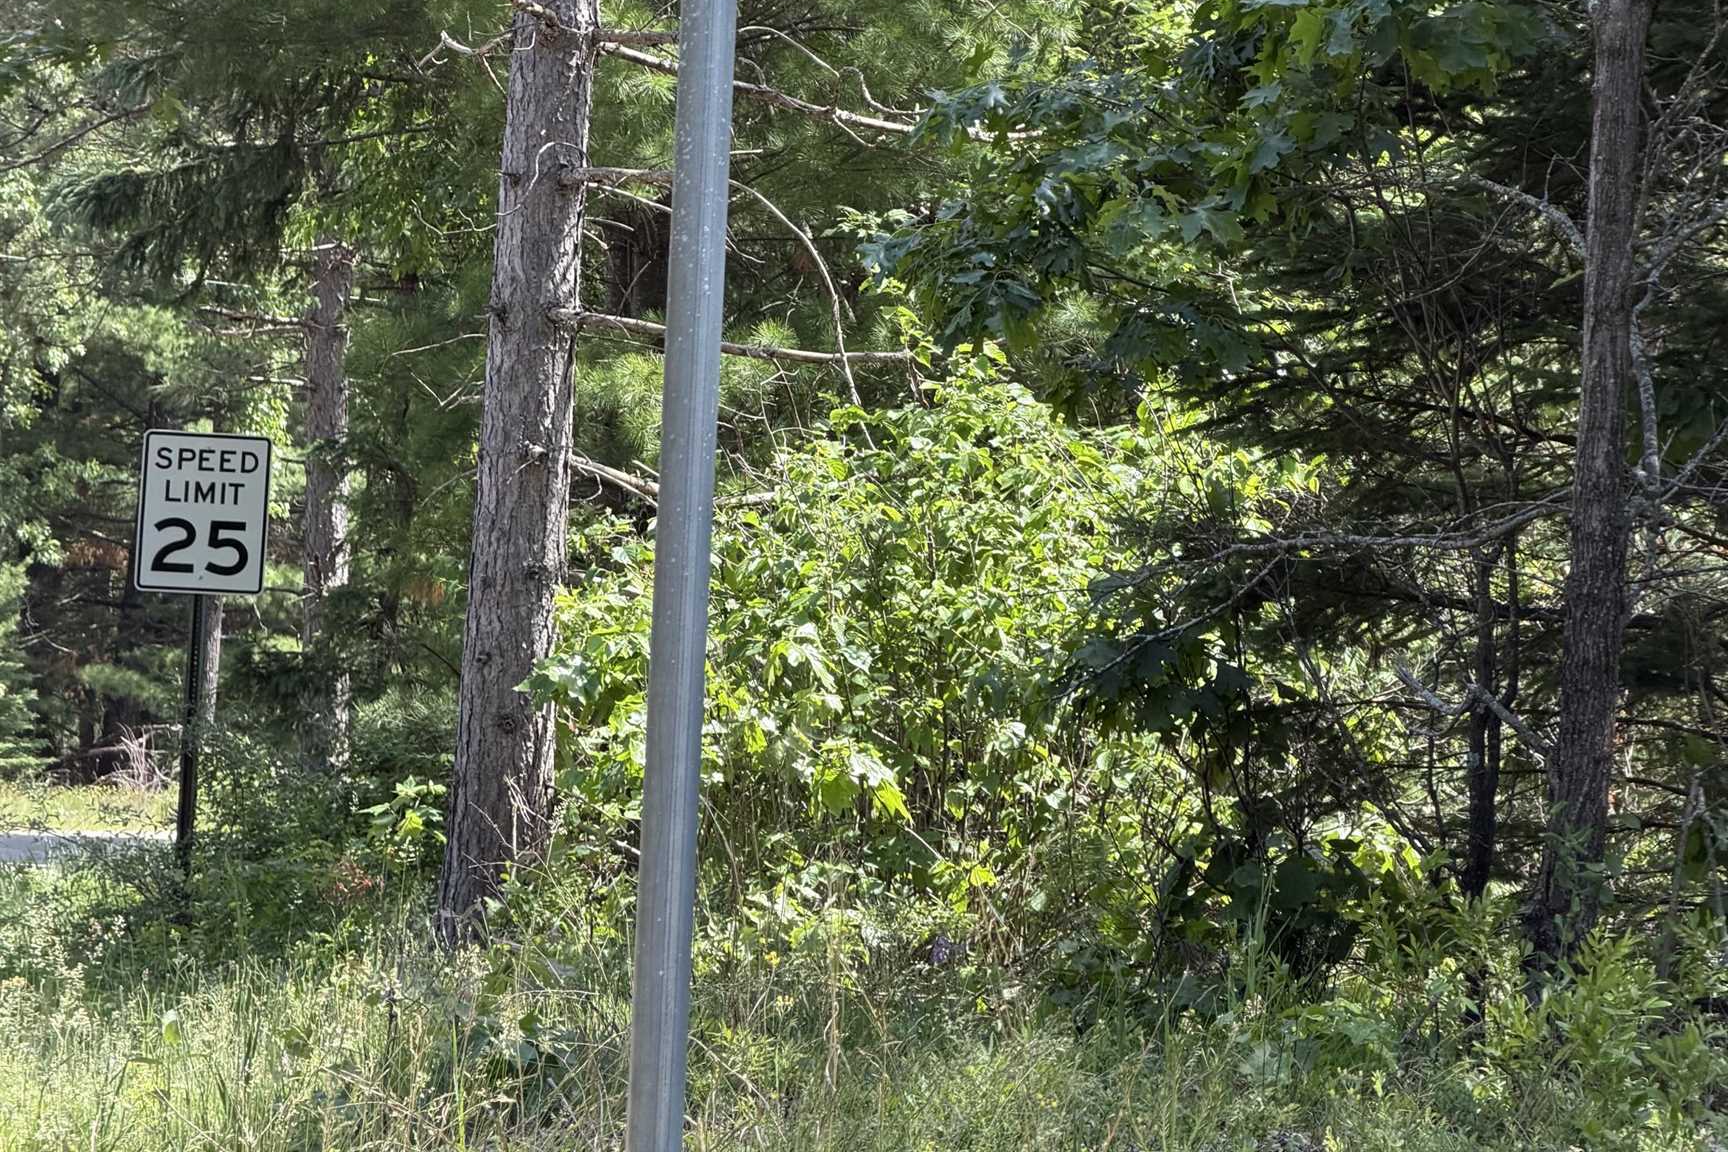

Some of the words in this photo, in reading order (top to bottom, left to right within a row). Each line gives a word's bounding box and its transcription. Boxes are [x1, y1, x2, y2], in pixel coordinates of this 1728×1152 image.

[155, 447, 259, 473] SPEED
[165, 479, 245, 505] LIMIT
[151, 517, 248, 576] 25
